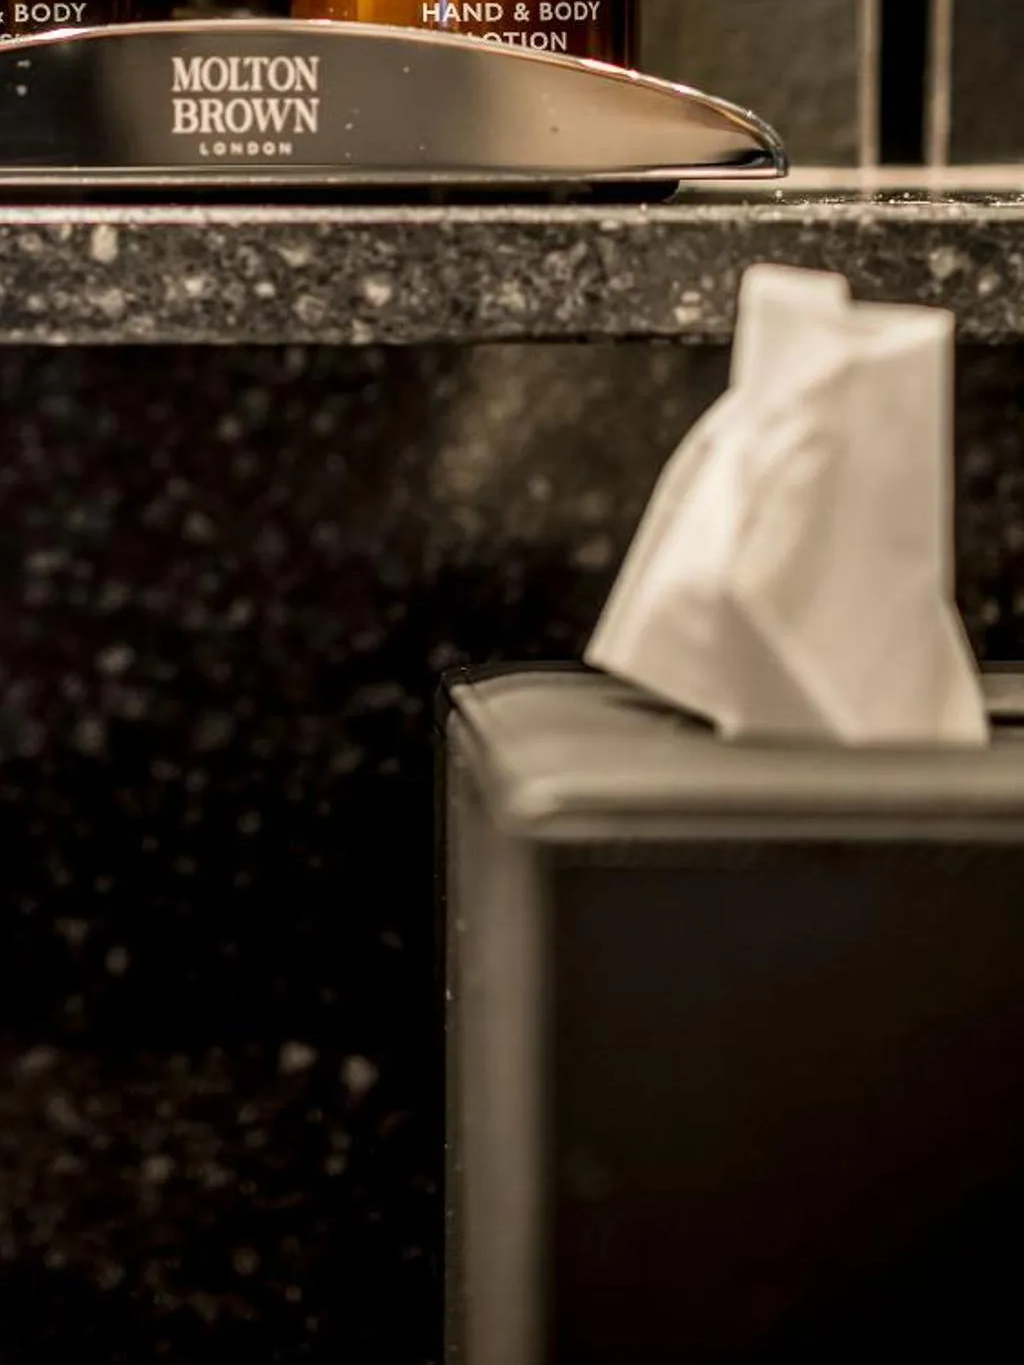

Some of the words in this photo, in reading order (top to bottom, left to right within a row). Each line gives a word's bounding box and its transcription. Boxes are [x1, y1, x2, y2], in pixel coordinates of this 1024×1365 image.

[14, 2, 87, 22] BODY
[422, 2, 504, 22] HAND
[513, 2, 530, 21] &
[539, 1, 601, 21] BODY
[467, 31, 567, 50] OTION
[171, 56, 320, 92] MOLTON
[171, 97, 320, 134] BROWN
[198, 141, 293, 156] LONDON
